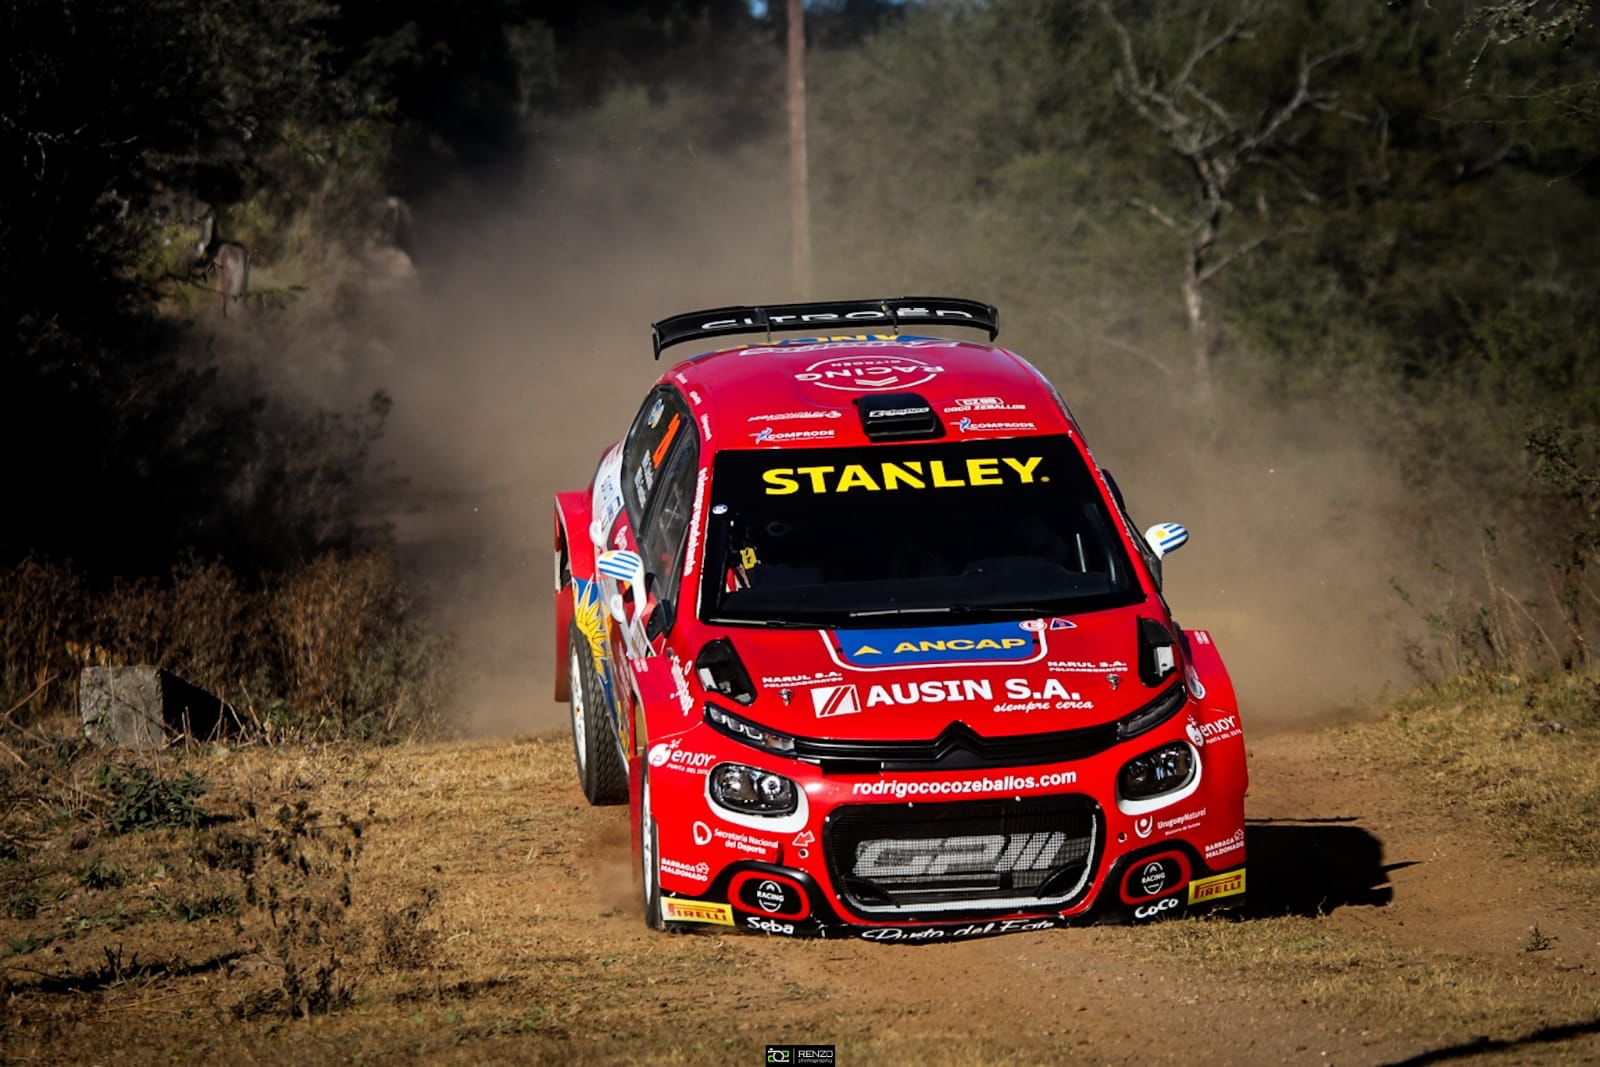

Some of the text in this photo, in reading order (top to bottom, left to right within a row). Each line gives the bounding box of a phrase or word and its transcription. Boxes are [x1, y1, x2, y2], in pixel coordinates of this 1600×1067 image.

[794, 364, 945, 381] RACING
[768, 430, 835, 439] COMPRODE
[893, 639, 1026, 653] ANCAP
[866, 678, 1081, 708] AUSIN S.A.
[993, 700, 1094, 713] siempre cerca
[853, 771, 1077, 798] rodrigococozeballos.com
[725, 839, 767, 855] del Deporte
[748, 835, 779, 848] Nacional
[1206, 840, 1245, 859] MALDONADO
[661, 865, 708, 882] MALDONADO
[1141, 872, 1166, 884] RACING
[1194, 874, 1242, 899] PIRELLI
[757, 890, 784, 902] RACING
[668, 903, 727, 921] PIRELLI
[746, 917, 794, 935] Seba
